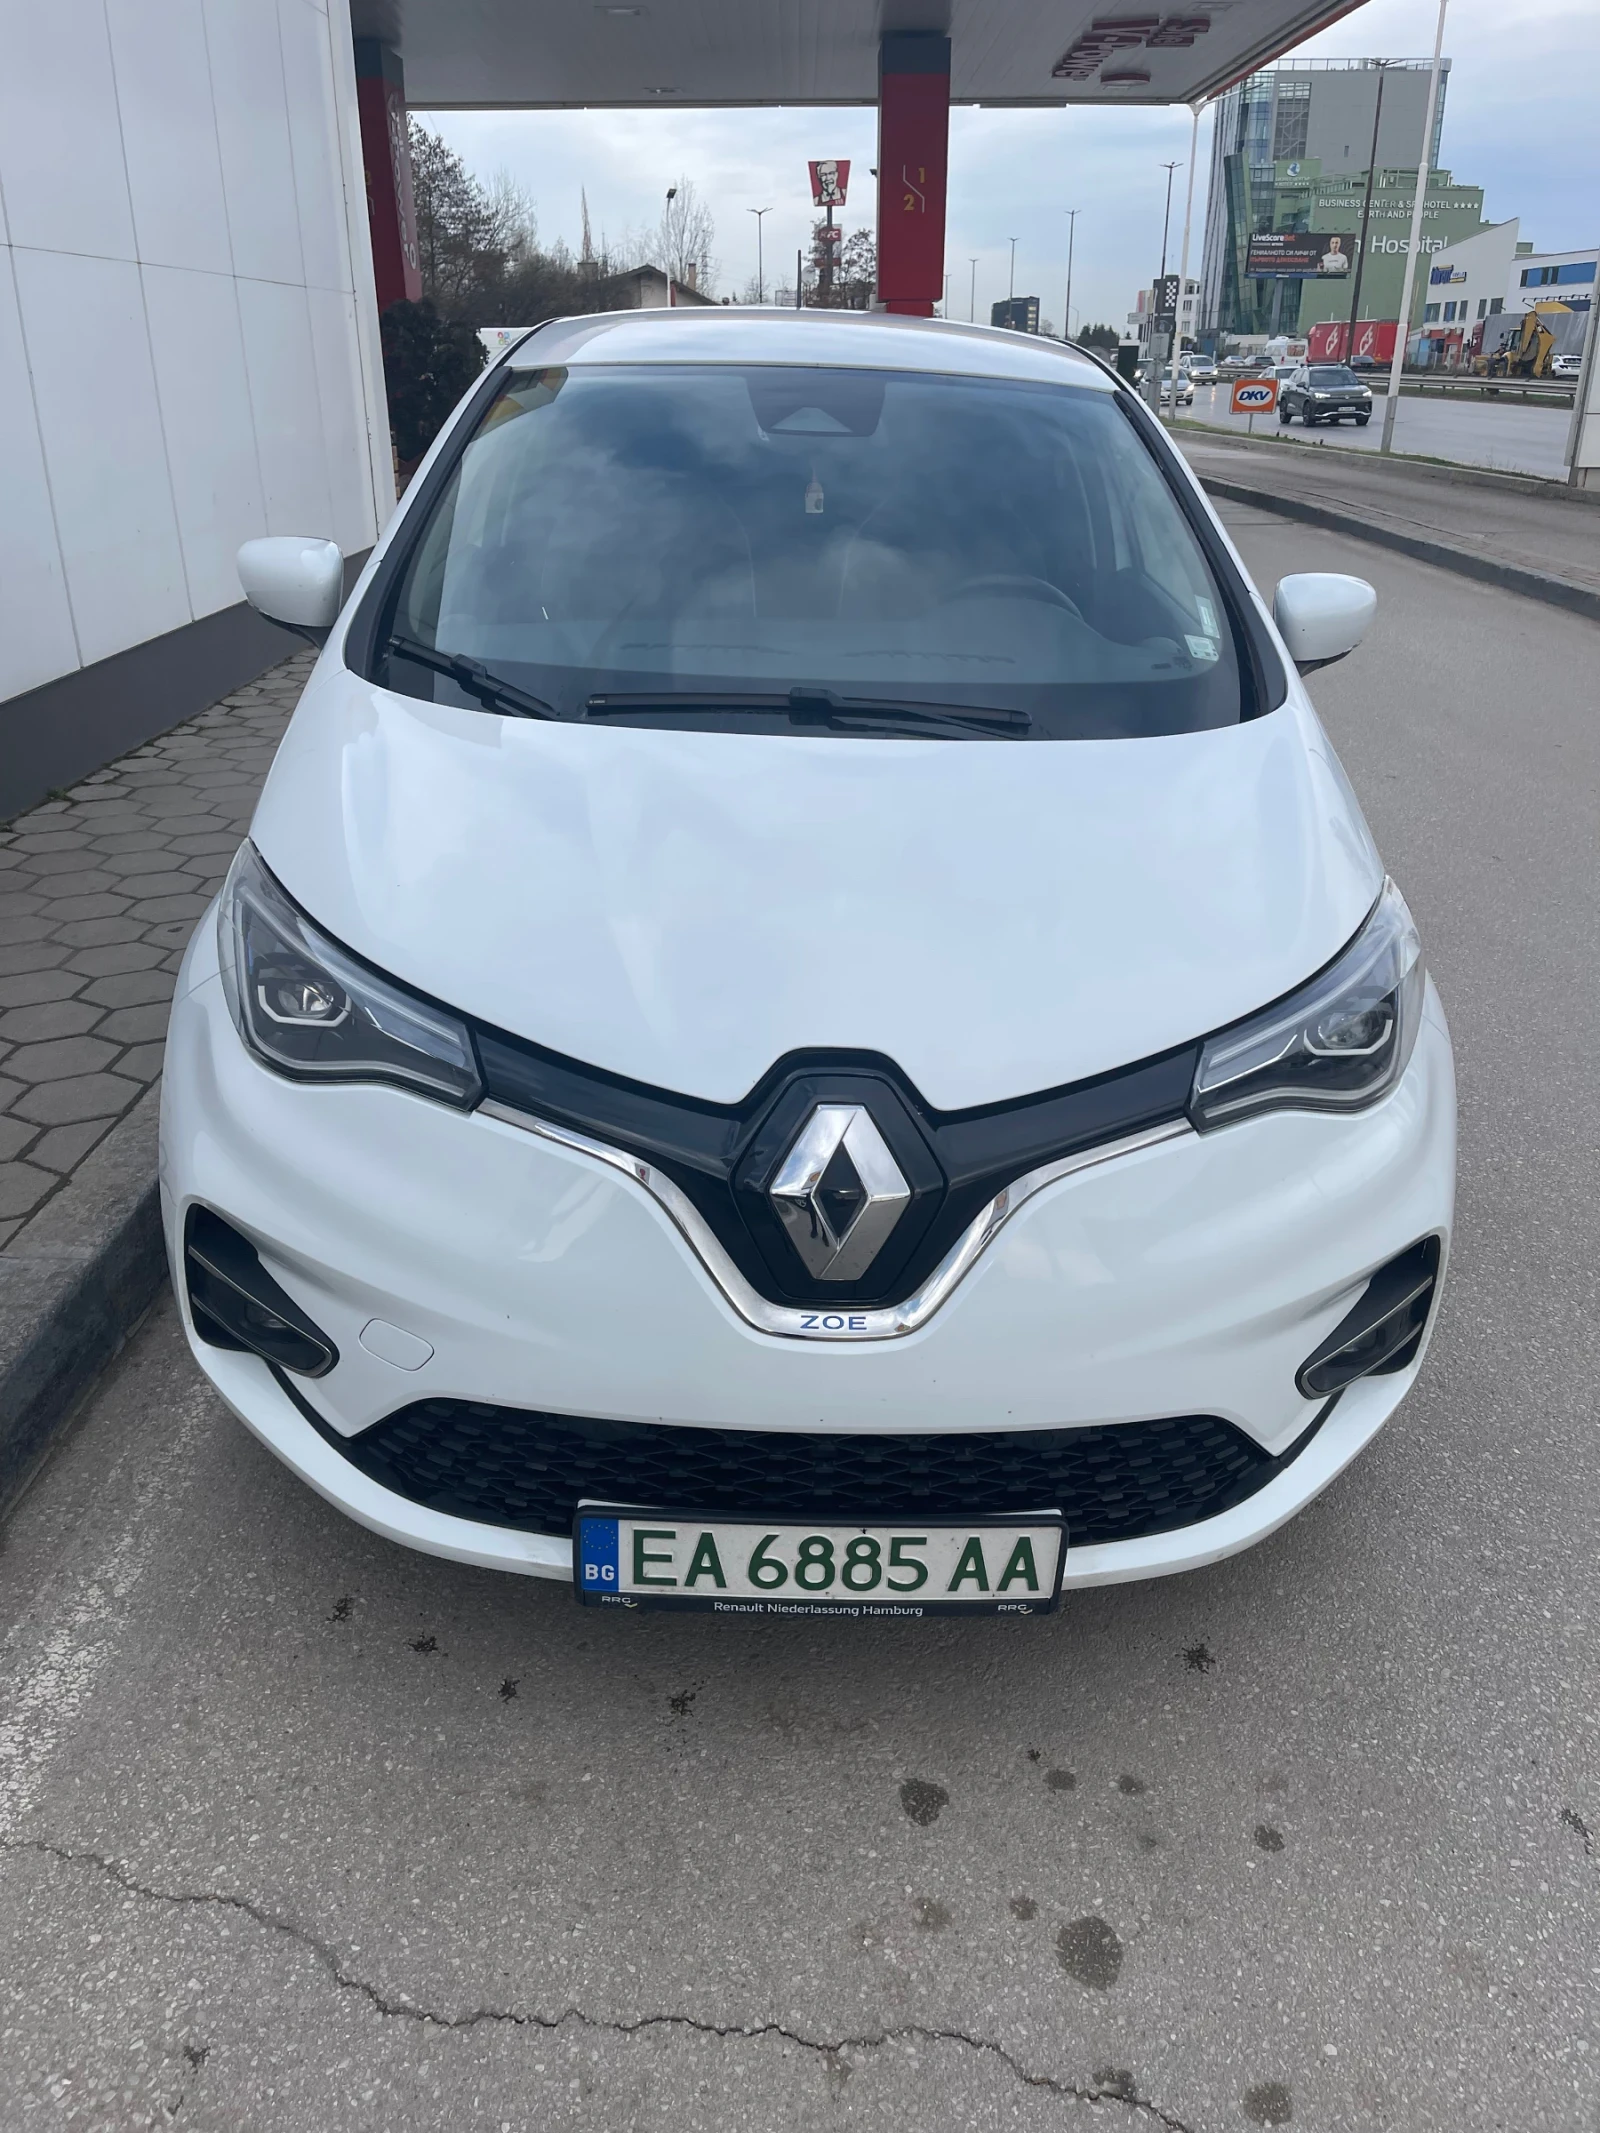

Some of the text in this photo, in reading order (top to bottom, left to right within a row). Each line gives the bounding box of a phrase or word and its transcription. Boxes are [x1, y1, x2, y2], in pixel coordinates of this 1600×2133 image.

[918, 167, 925, 183] 1
[903, 194, 915, 211] 2
[1319, 199, 1361, 208] BUSINESS
[1397, 200, 1404, 209] &
[1423, 201, 1451, 209] HOTEL
[1357, 210, 1439, 219] ERTH AND PPLE
[1238, 390, 1270, 401] DKV
[800, 1315, 868, 1330] ZOE
[633, 1529, 1040, 1592] EA 6885 AA
[585, 1564, 615, 1581] BG
[601, 1595, 631, 1603] RRG
[714, 1601, 923, 1617] Renault Niederlassung Hamburg
